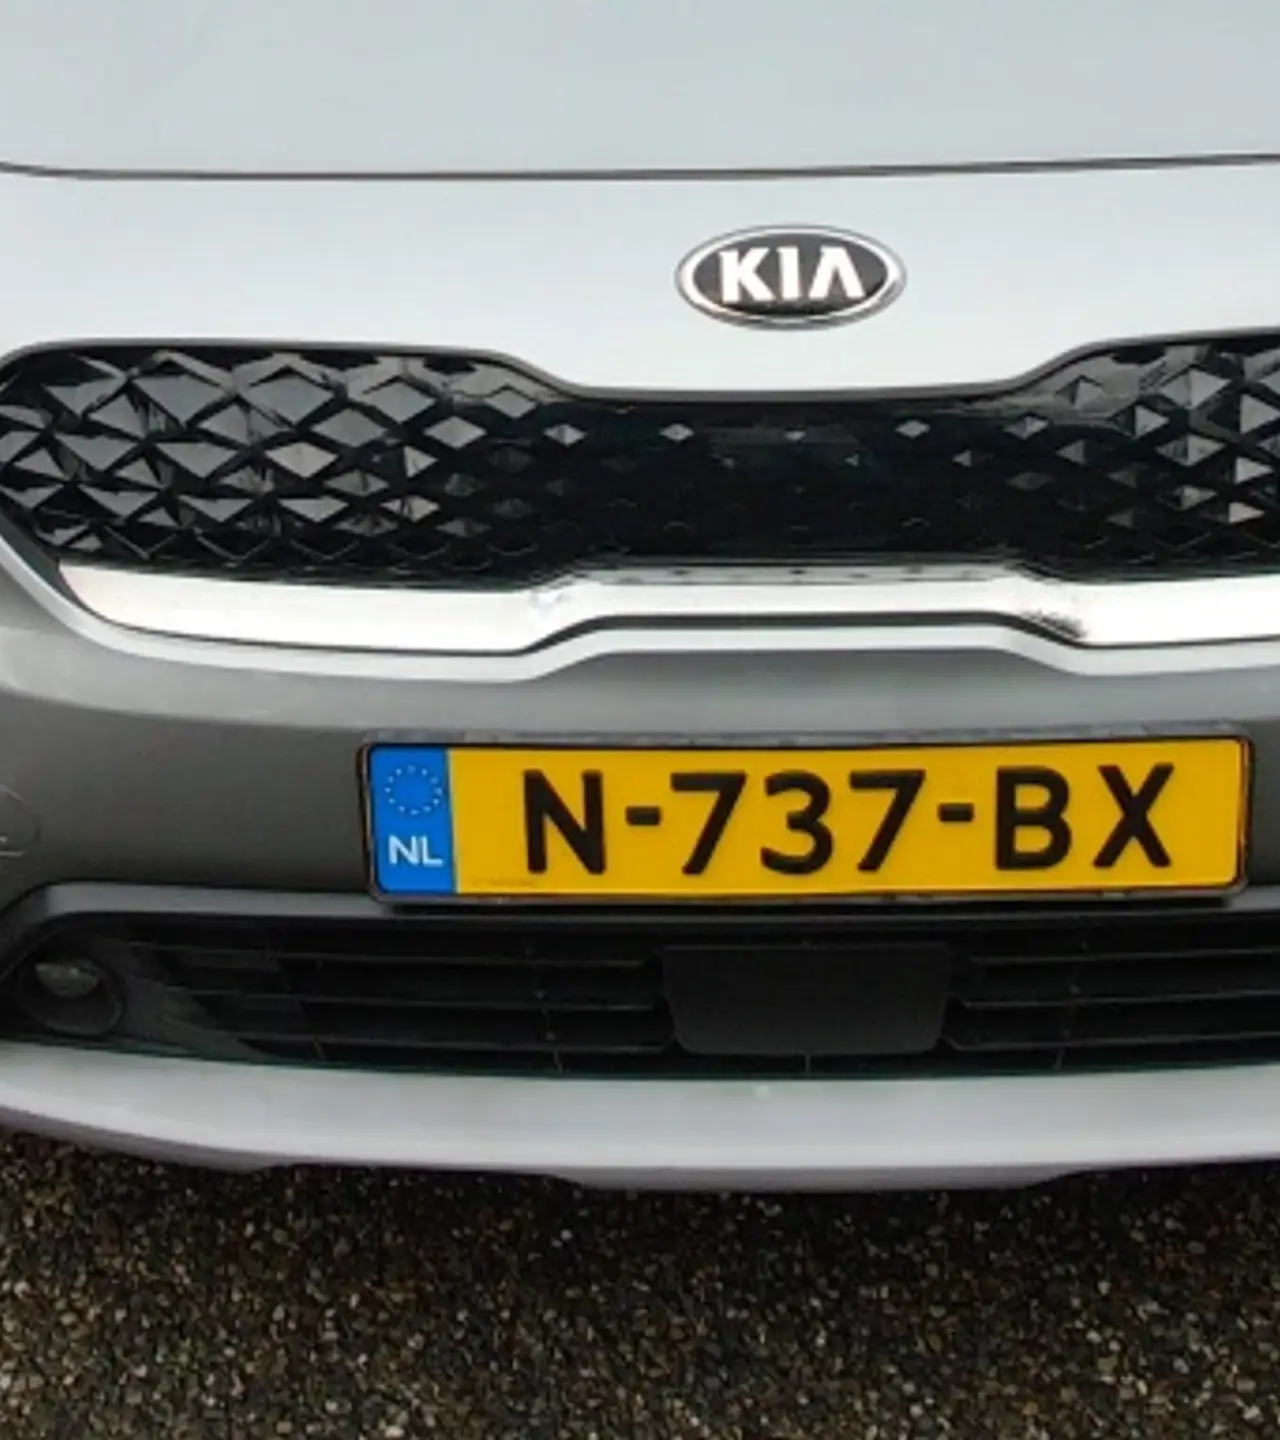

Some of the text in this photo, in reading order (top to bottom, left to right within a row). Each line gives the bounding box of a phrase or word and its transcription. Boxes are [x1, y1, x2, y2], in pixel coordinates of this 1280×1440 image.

[718, 245, 866, 305] KIA
[387, 763, 1176, 876] NL N-737-BX
